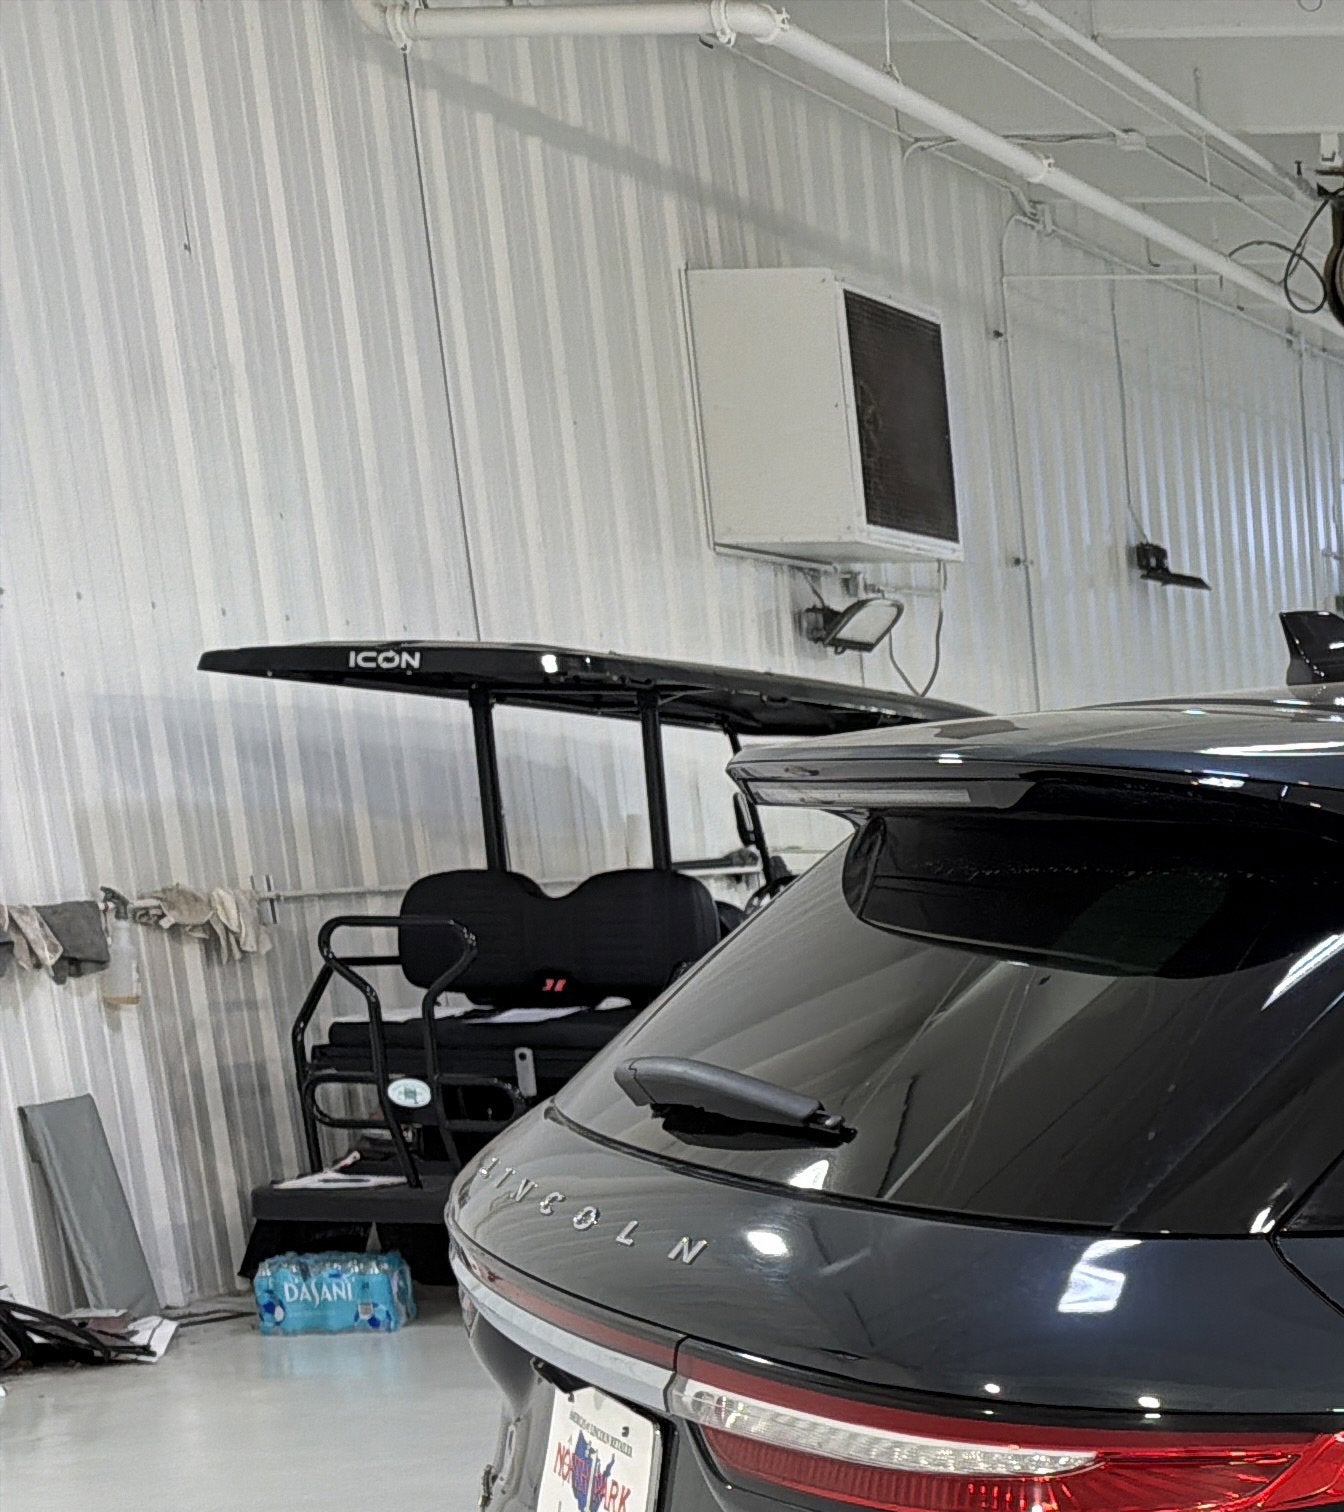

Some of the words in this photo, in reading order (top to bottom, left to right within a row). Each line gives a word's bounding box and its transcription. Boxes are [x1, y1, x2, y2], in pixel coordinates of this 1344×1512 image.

[348, 649, 421, 669] ICON
[478, 1156, 709, 1265] LINCOLN
[284, 1276, 353, 1309] DASANI
